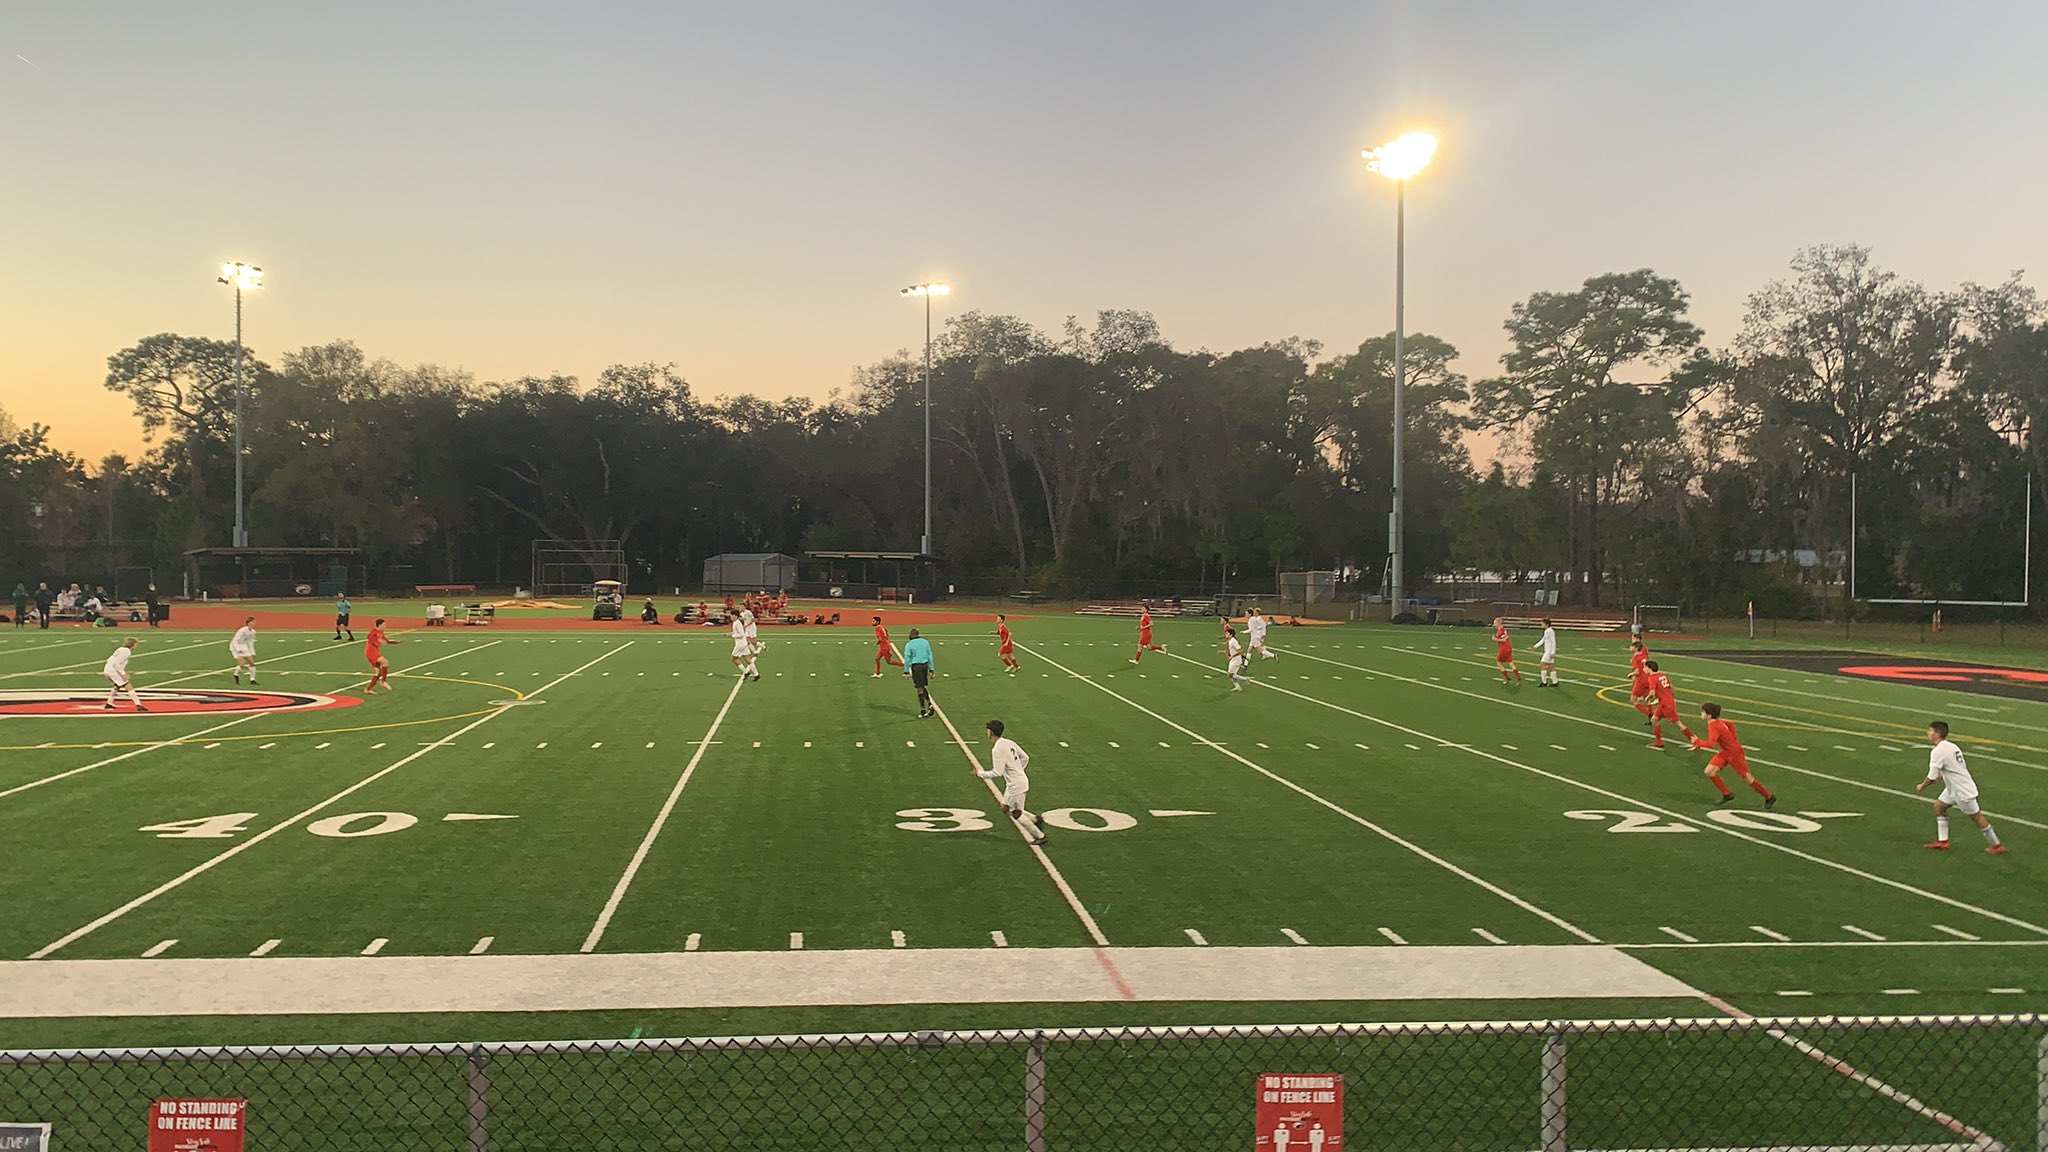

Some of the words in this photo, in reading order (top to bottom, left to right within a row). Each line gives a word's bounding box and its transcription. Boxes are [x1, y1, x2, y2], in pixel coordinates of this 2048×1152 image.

[1265, 1077, 1281, 1089] NO
[1282, 1077, 1334, 1089] STANDING
[1263, 1091, 1279, 1103] ON
[1280, 1091, 1312, 1104] FENCE
[1313, 1091, 1336, 1103] LINE
[160, 1101, 177, 1114] NO
[179, 1101, 238, 1115] STANDING
[157, 1117, 174, 1130] ON
[176, 1117, 212, 1130] FENCE
[214, 1117, 238, 1130] LINE
